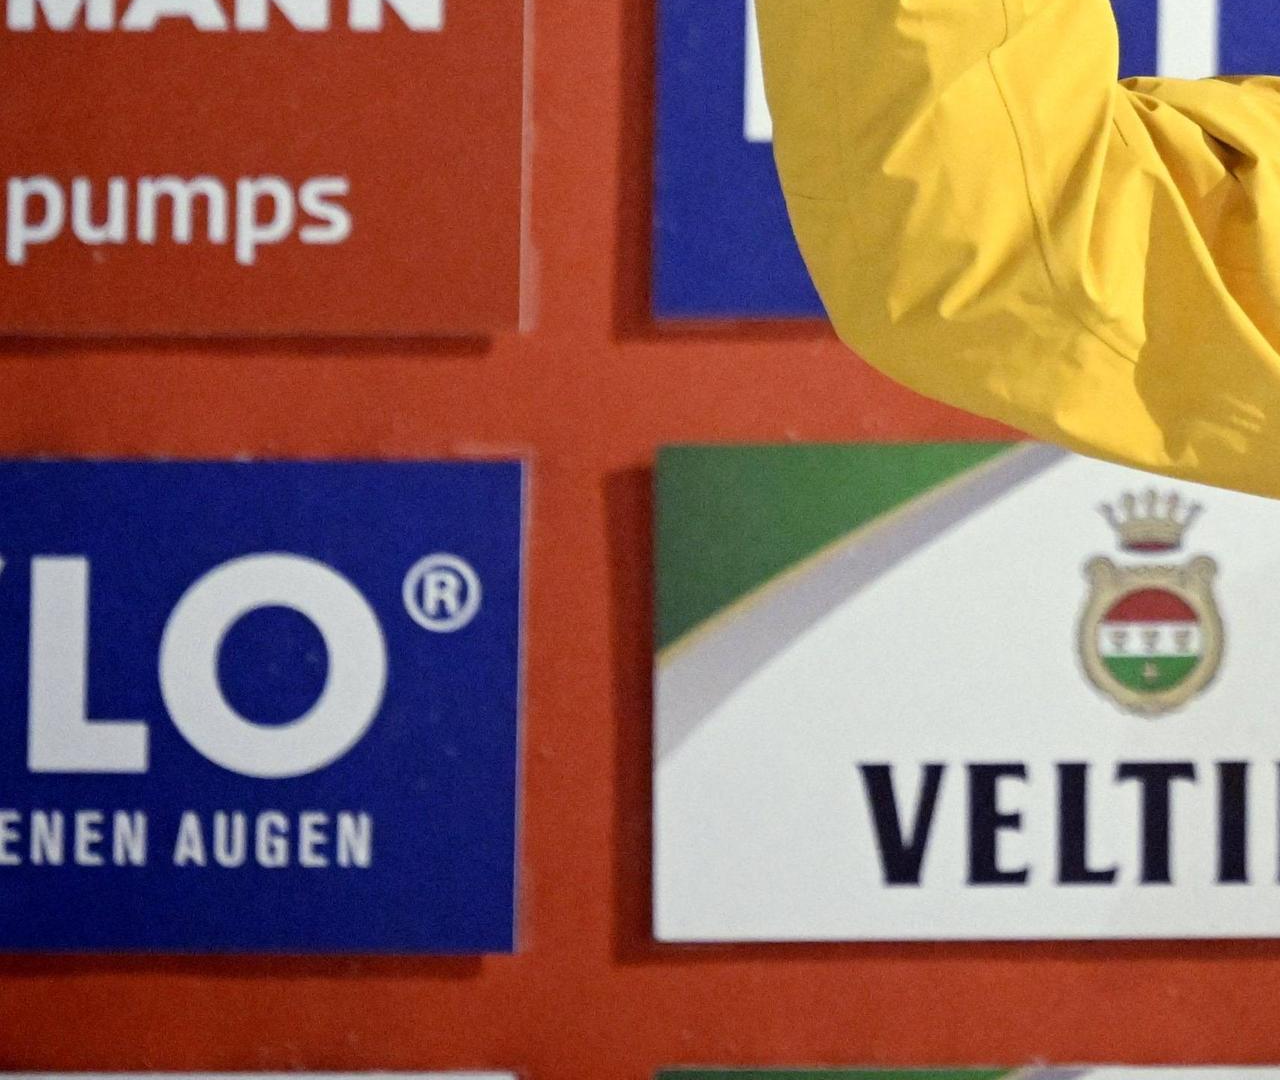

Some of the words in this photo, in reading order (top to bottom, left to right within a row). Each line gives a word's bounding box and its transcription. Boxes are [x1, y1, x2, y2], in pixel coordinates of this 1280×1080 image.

[6, 175, 353, 266] pumps
[0, 552, 482, 778] LO®
[0, 809, 147, 866] ENEN
[174, 809, 372, 866] AUGEN
